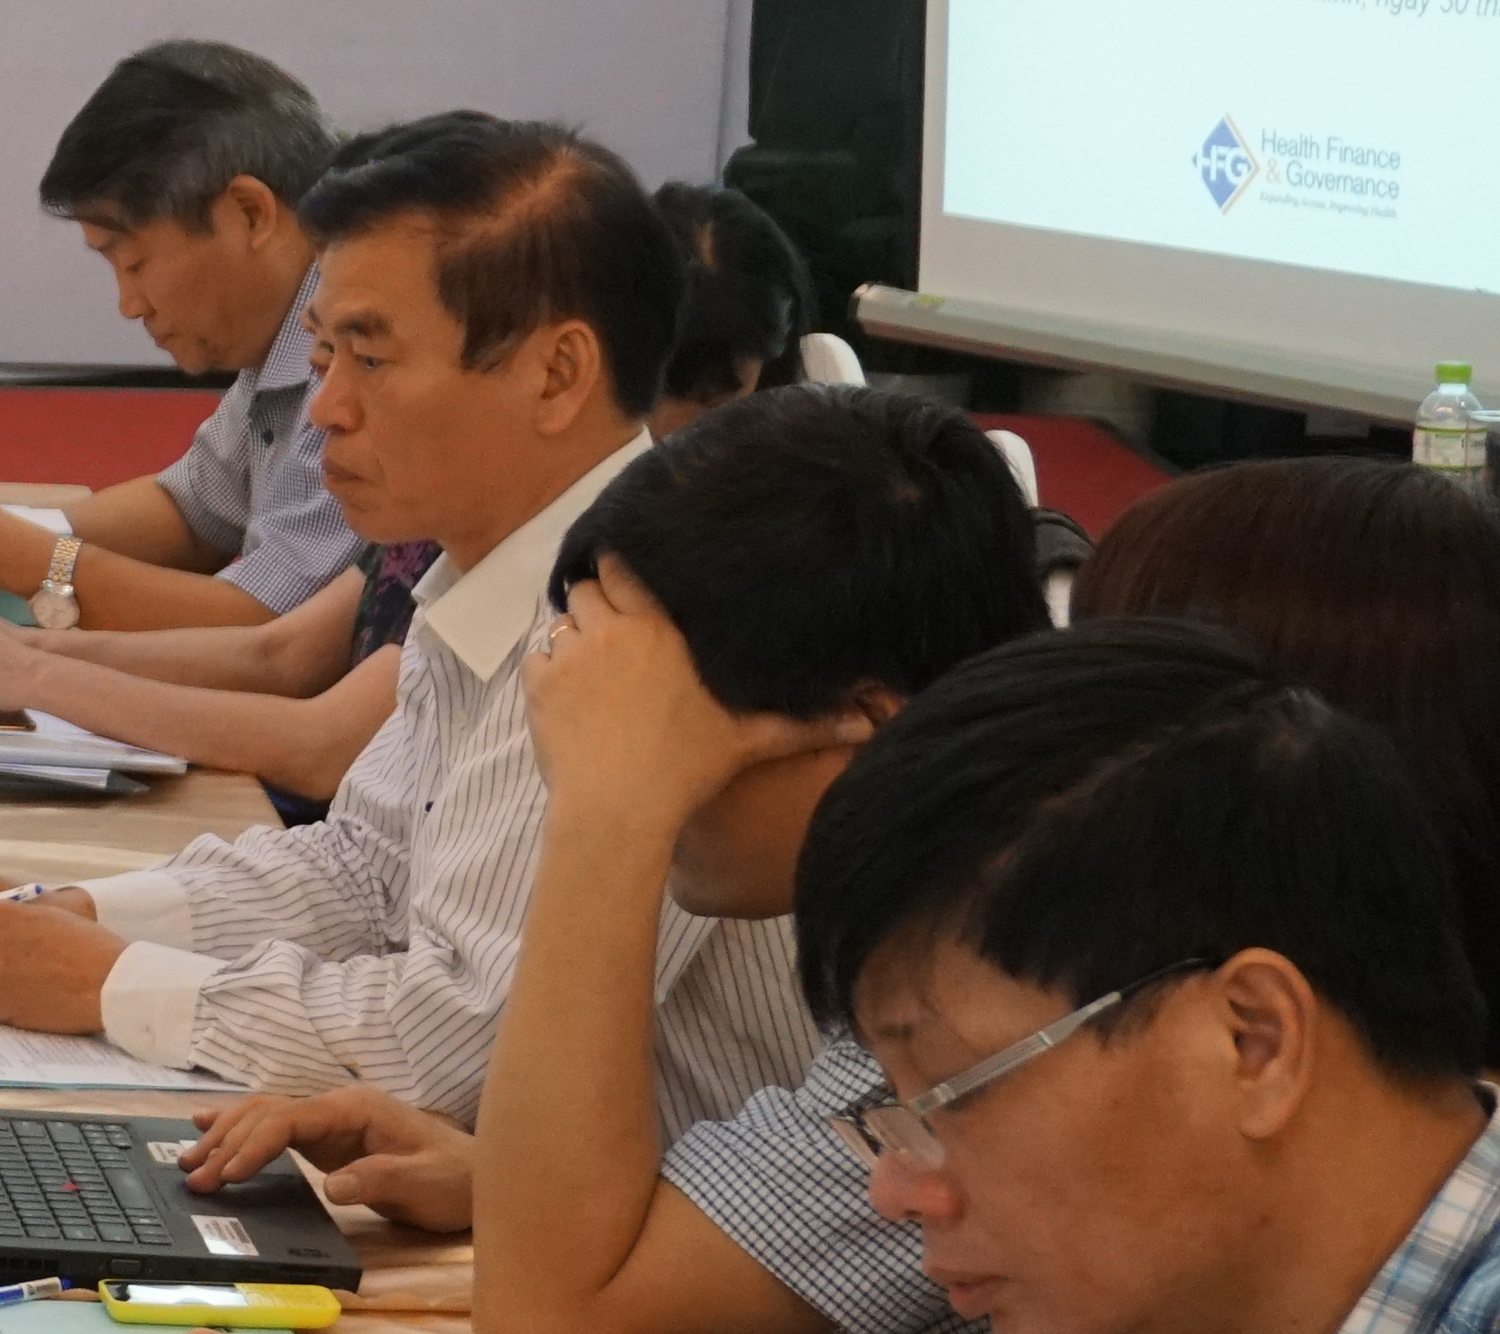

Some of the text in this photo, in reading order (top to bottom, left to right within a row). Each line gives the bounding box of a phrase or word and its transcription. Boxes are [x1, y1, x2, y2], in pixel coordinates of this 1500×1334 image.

[1261, 129, 1401, 170] Health Finance
[1265, 154, 1401, 201] & Governance
